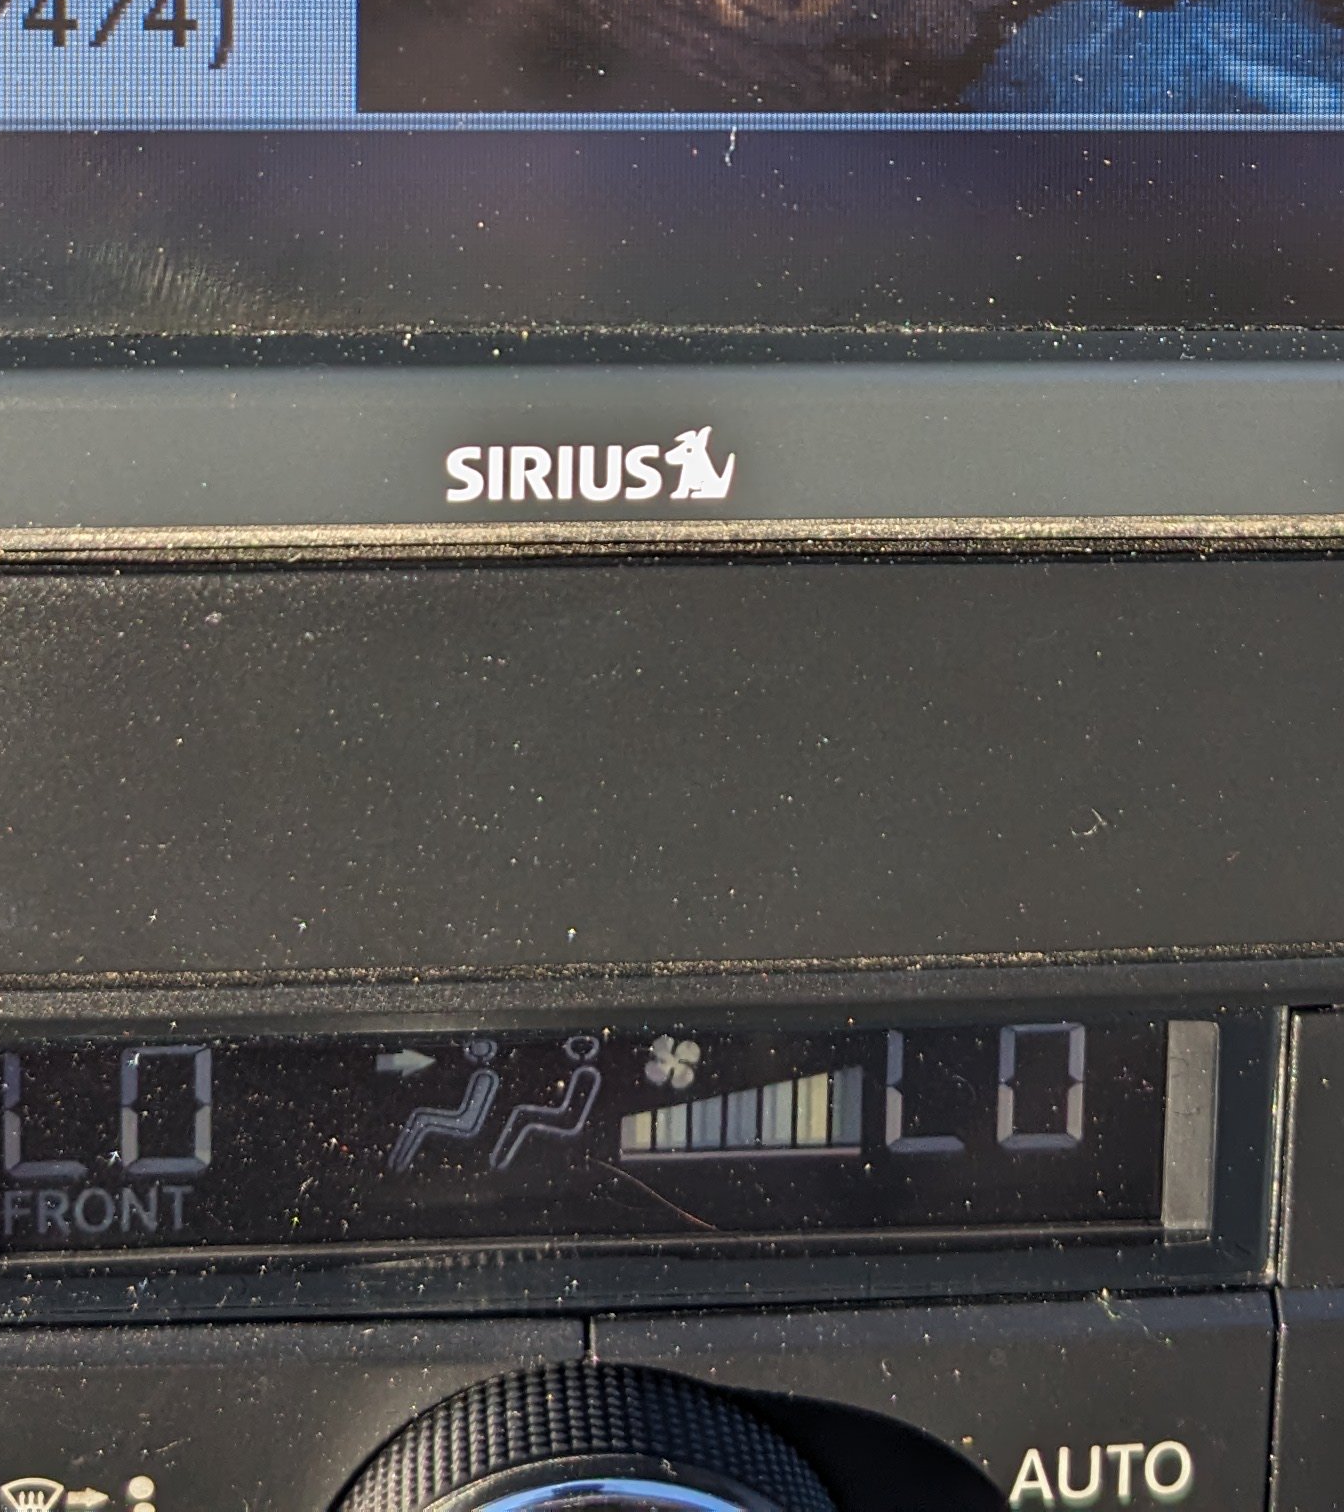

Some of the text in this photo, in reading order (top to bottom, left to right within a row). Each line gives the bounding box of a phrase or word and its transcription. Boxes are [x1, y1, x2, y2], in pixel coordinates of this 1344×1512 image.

[445, 444, 663, 502] SIRIUS
[1, 1185, 192, 1235] FRONT
[1008, 1440, 1191, 1505] AUTO
